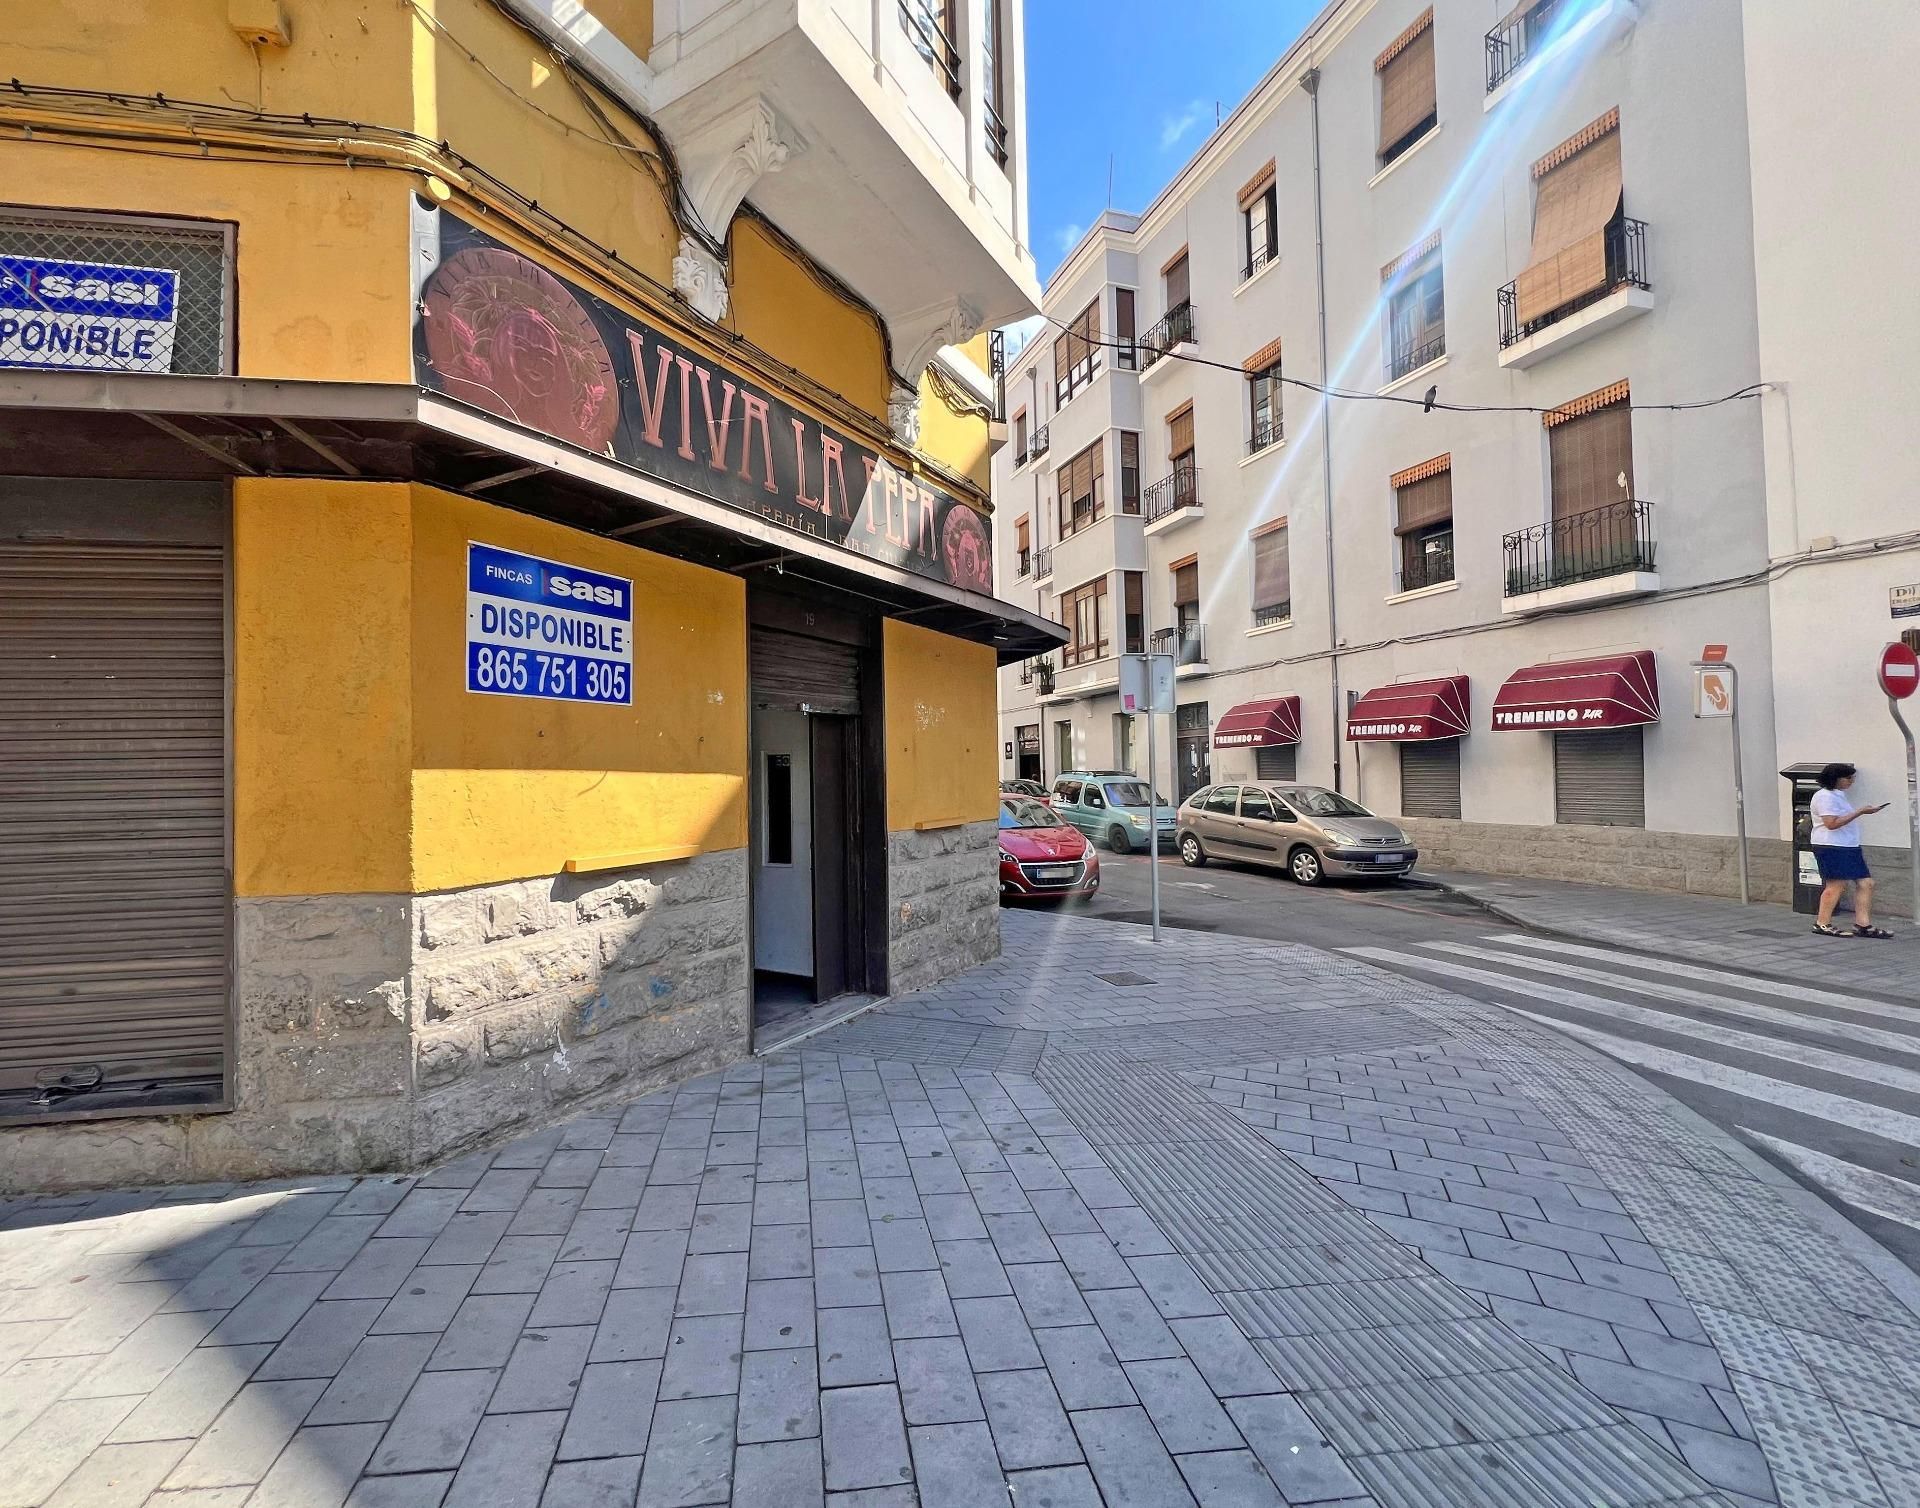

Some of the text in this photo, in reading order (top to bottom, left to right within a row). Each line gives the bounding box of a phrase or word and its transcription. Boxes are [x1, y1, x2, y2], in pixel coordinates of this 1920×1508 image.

[625, 327, 779, 495] VIVA
[790, 417, 852, 526] LA
[862, 455, 938, 562] PEPA
[486, 564, 624, 608] FINCAS sasi
[481, 603, 624, 654] DISPONIBLE
[477, 647, 626, 700] 865 751 305
[1215, 733, 1252, 744] TREMENDO
[1349, 723, 1406, 736] TREMENDO
[1496, 708, 1579, 725] TREMENDO
